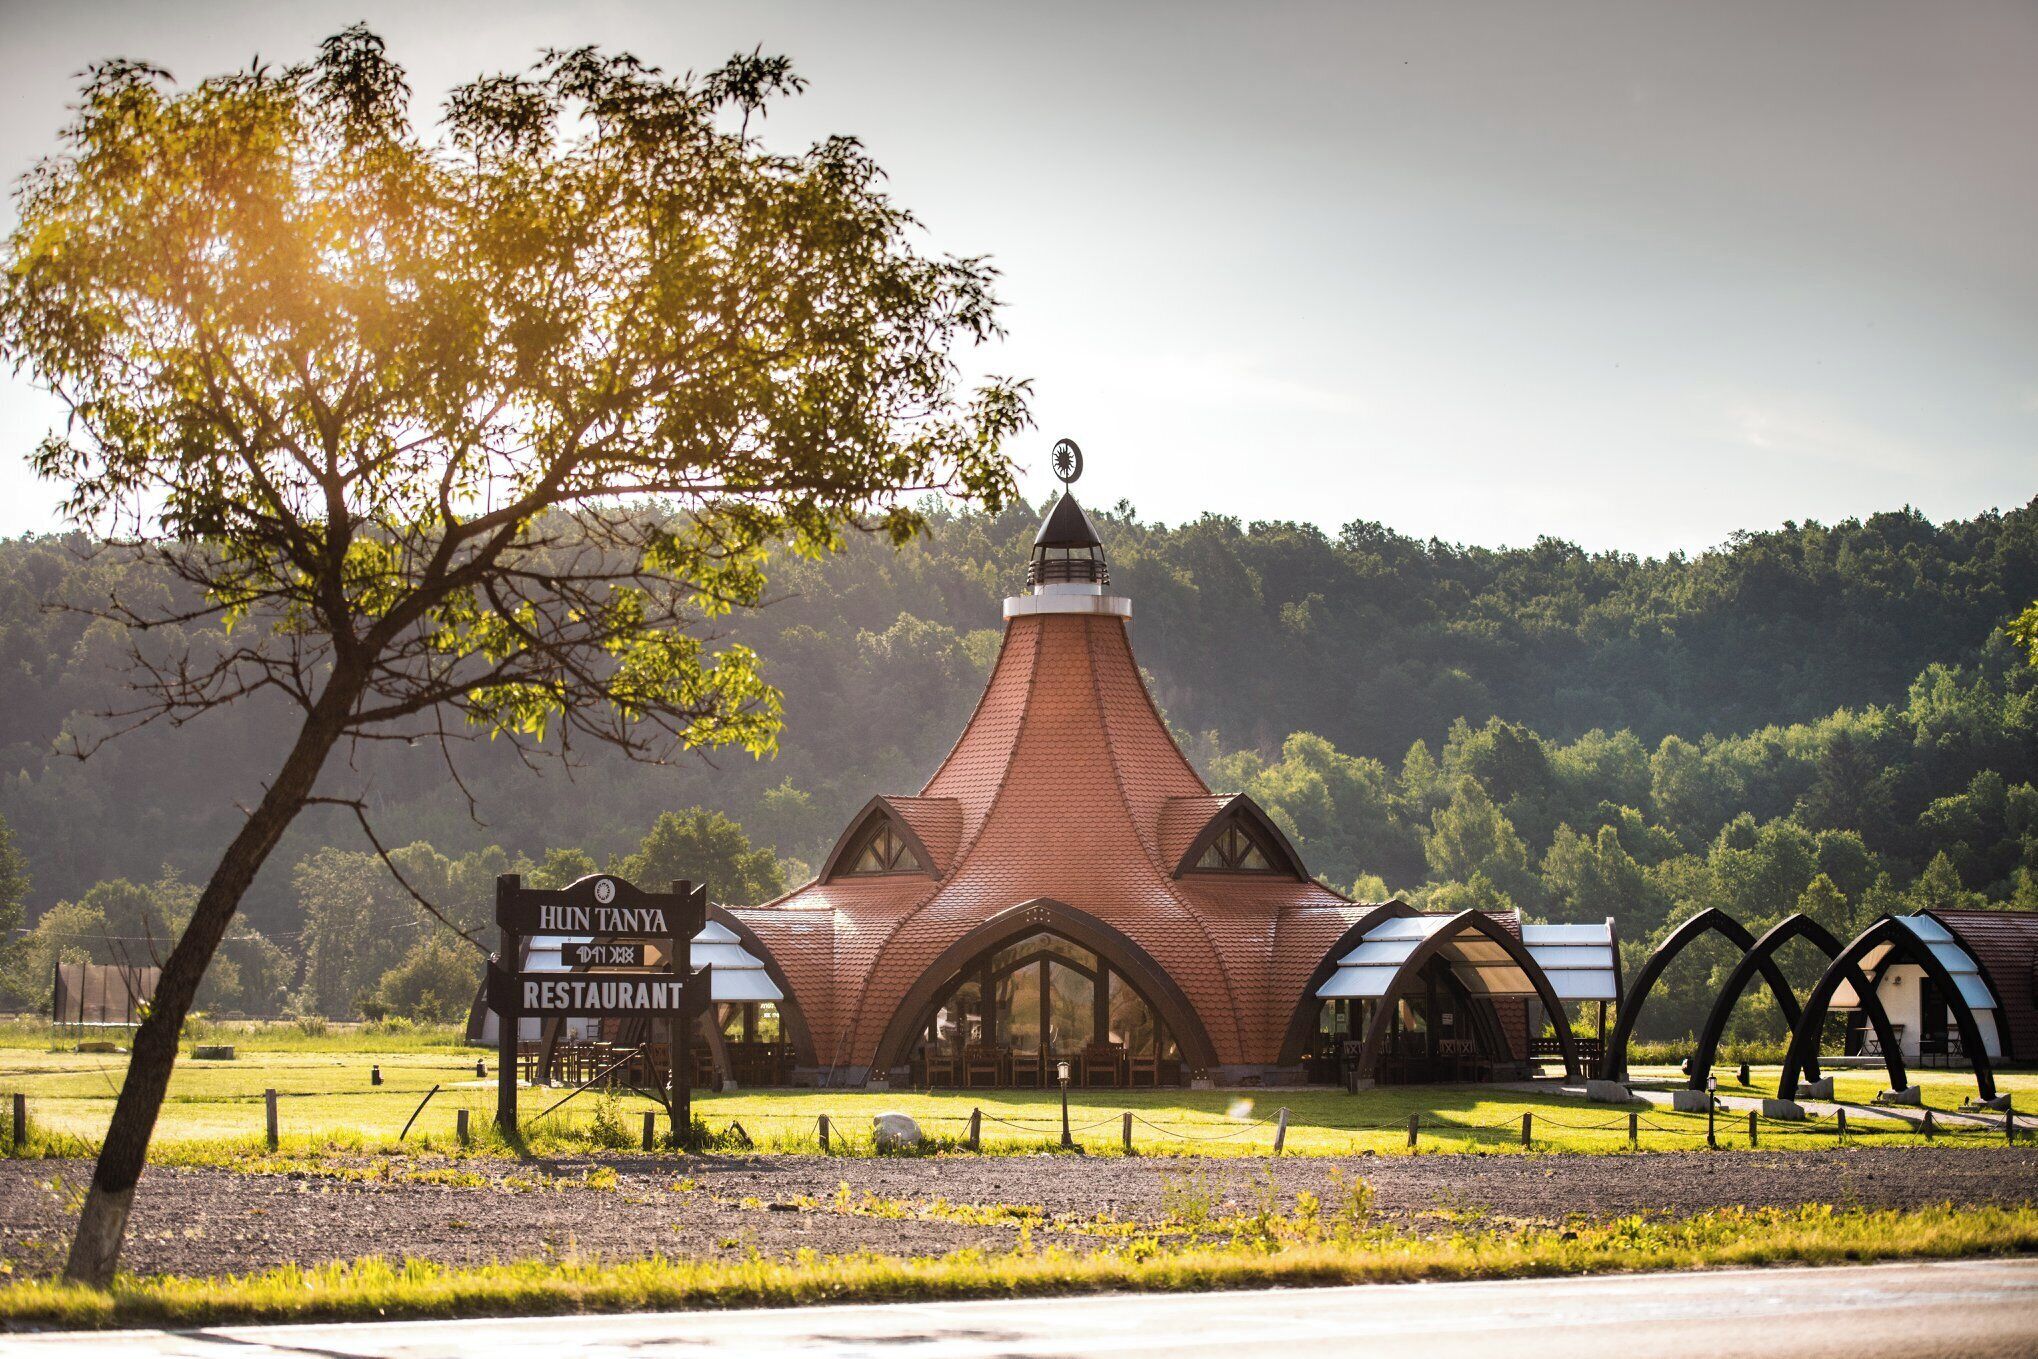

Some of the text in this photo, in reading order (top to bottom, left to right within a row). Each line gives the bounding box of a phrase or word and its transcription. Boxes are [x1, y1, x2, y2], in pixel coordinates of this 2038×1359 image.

[539, 905, 668, 932] HUN TANYA
[523, 981, 683, 1009] RESTAURANT
